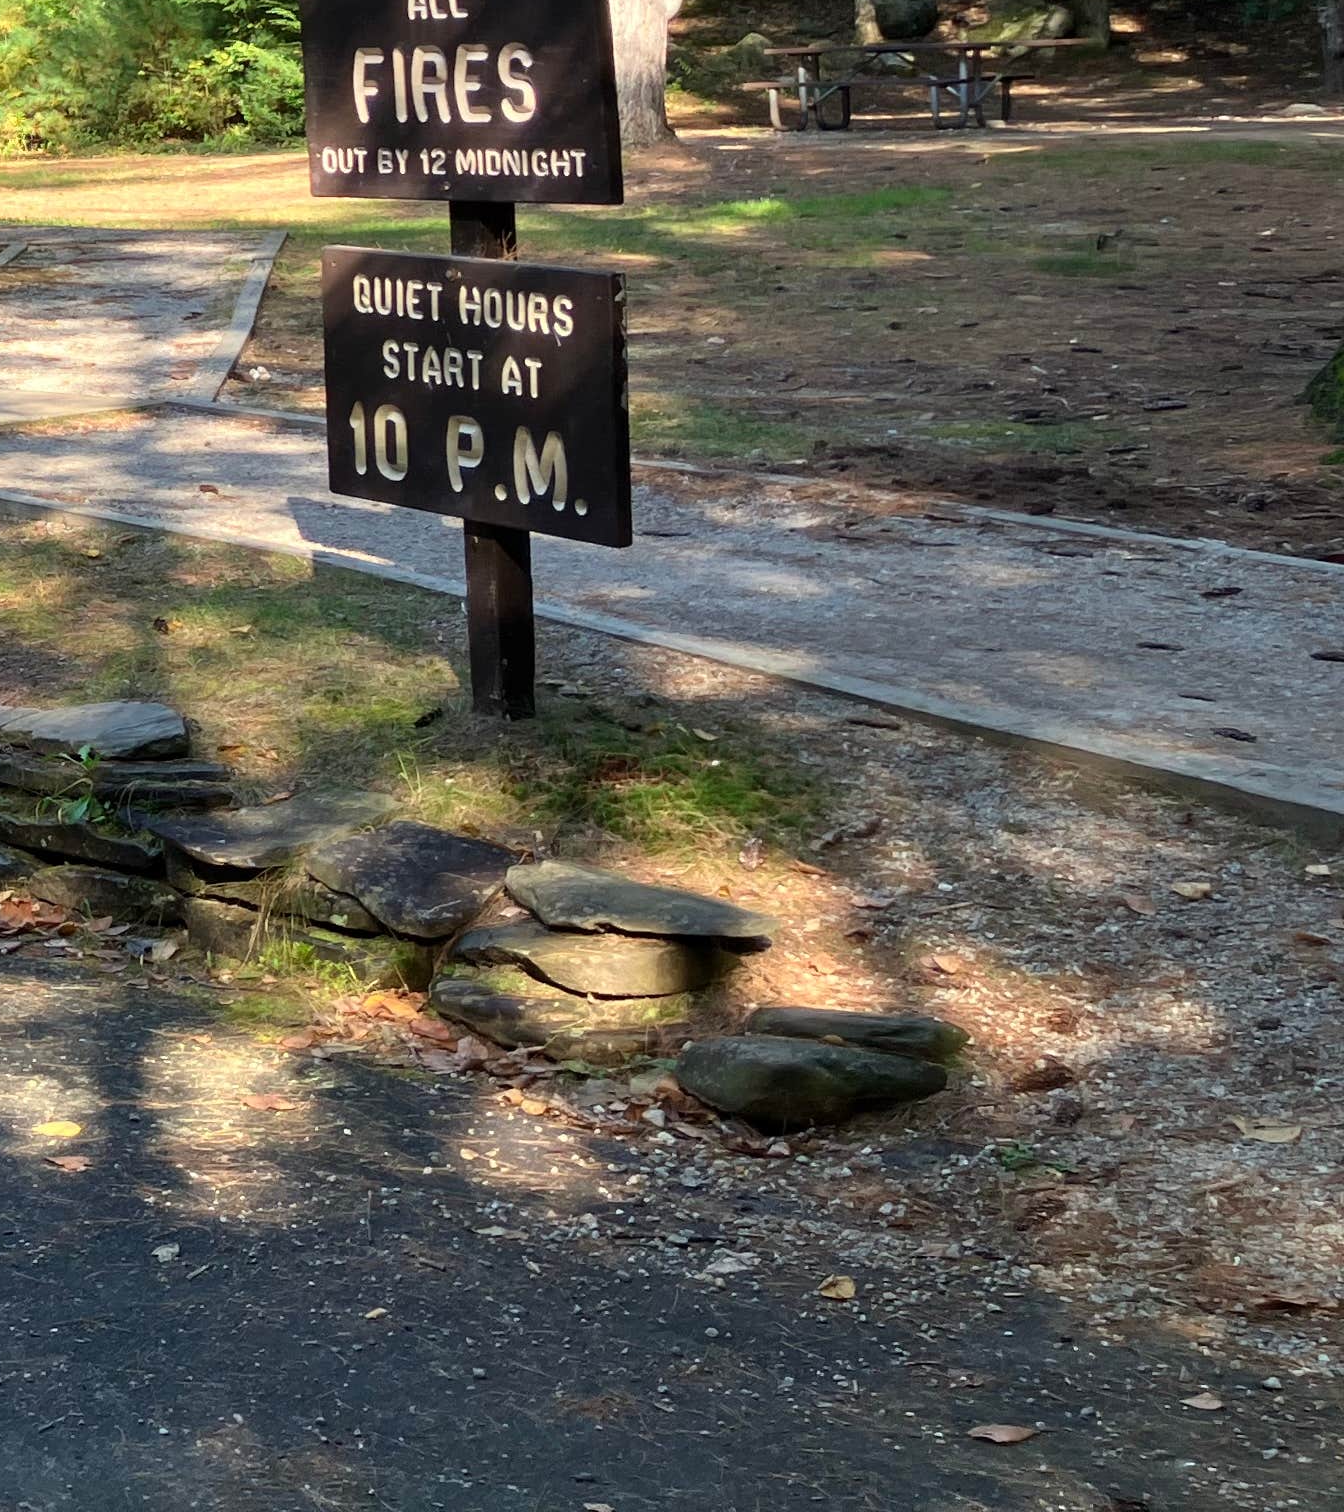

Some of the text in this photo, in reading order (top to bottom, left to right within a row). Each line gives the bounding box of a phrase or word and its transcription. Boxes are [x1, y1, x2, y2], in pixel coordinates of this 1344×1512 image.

[352, 42, 538, 124] FIRES
[321, 146, 587, 178] OUT BY 12 MIDNIGHT
[353, 273, 574, 337] QUIET HOURS
[382, 339, 543, 399] START AT
[349, 400, 588, 516] 10 P.M.
